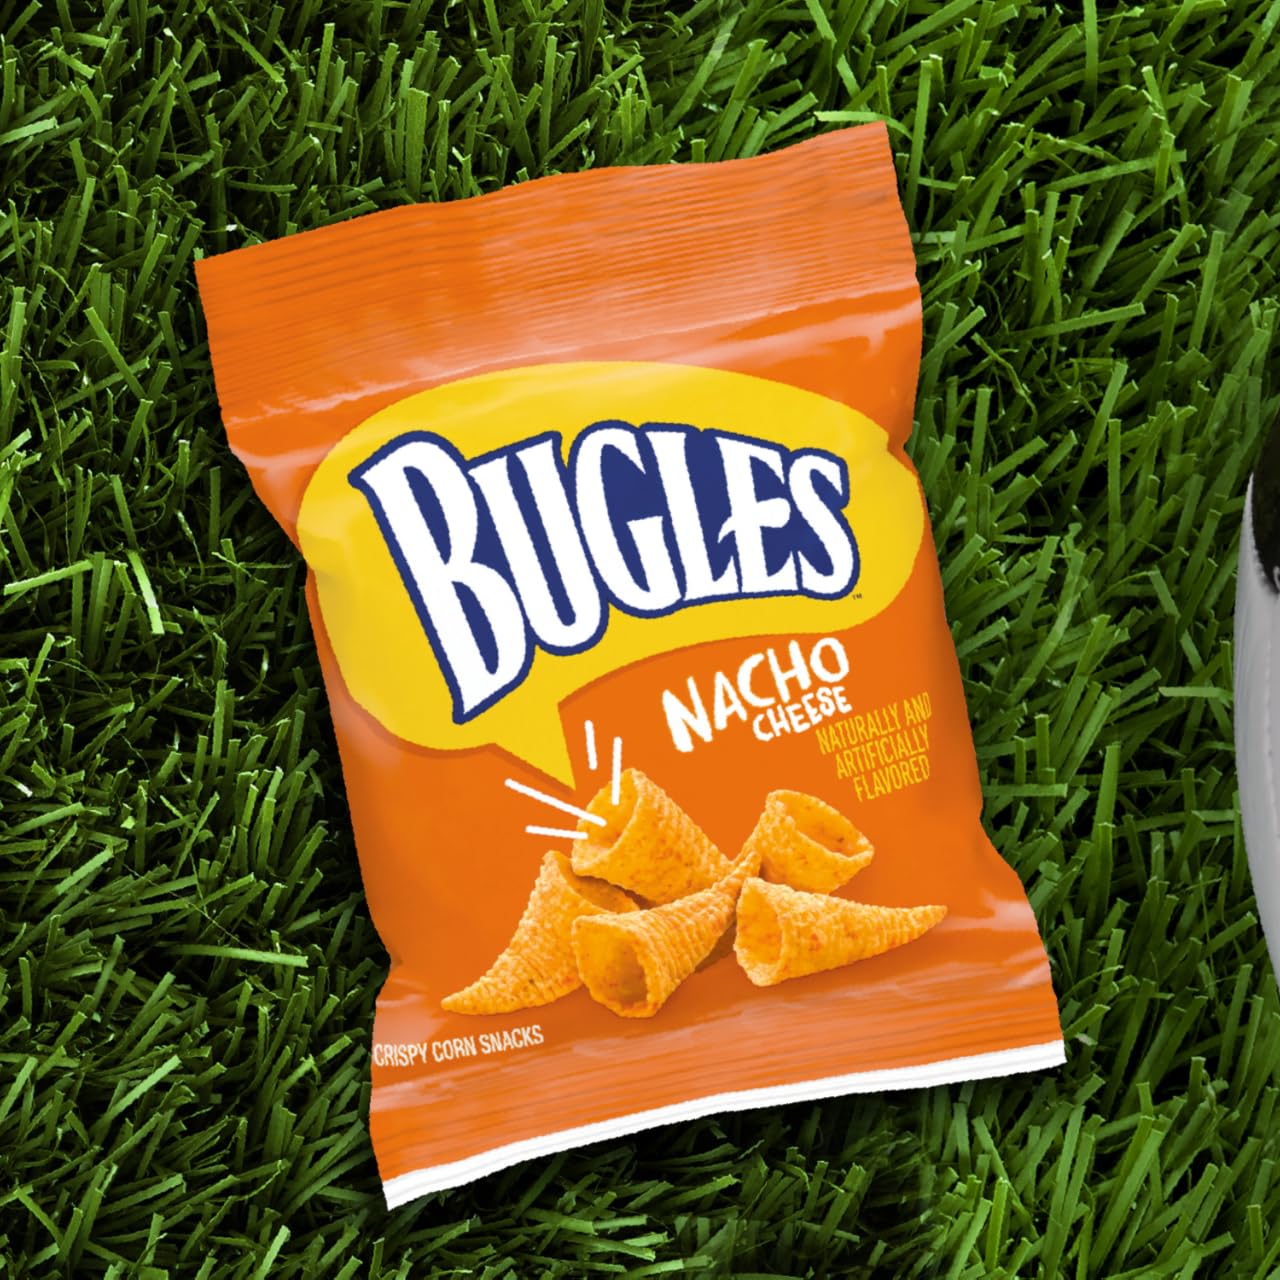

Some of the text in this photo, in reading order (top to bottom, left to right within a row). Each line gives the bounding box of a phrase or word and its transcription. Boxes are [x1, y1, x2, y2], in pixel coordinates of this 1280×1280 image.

[350, 420, 860, 722] BUGLES
[661, 637, 850, 753] NACHO
[751, 686, 853, 742] CHEESE
[815, 692, 932, 756] NATURALLY AND
[835, 724, 930, 780] ARTIFICIALLY
[853, 755, 930, 802] FLAVORED
[373, 1024, 544, 1068] CRISPY CORN SNACKS
